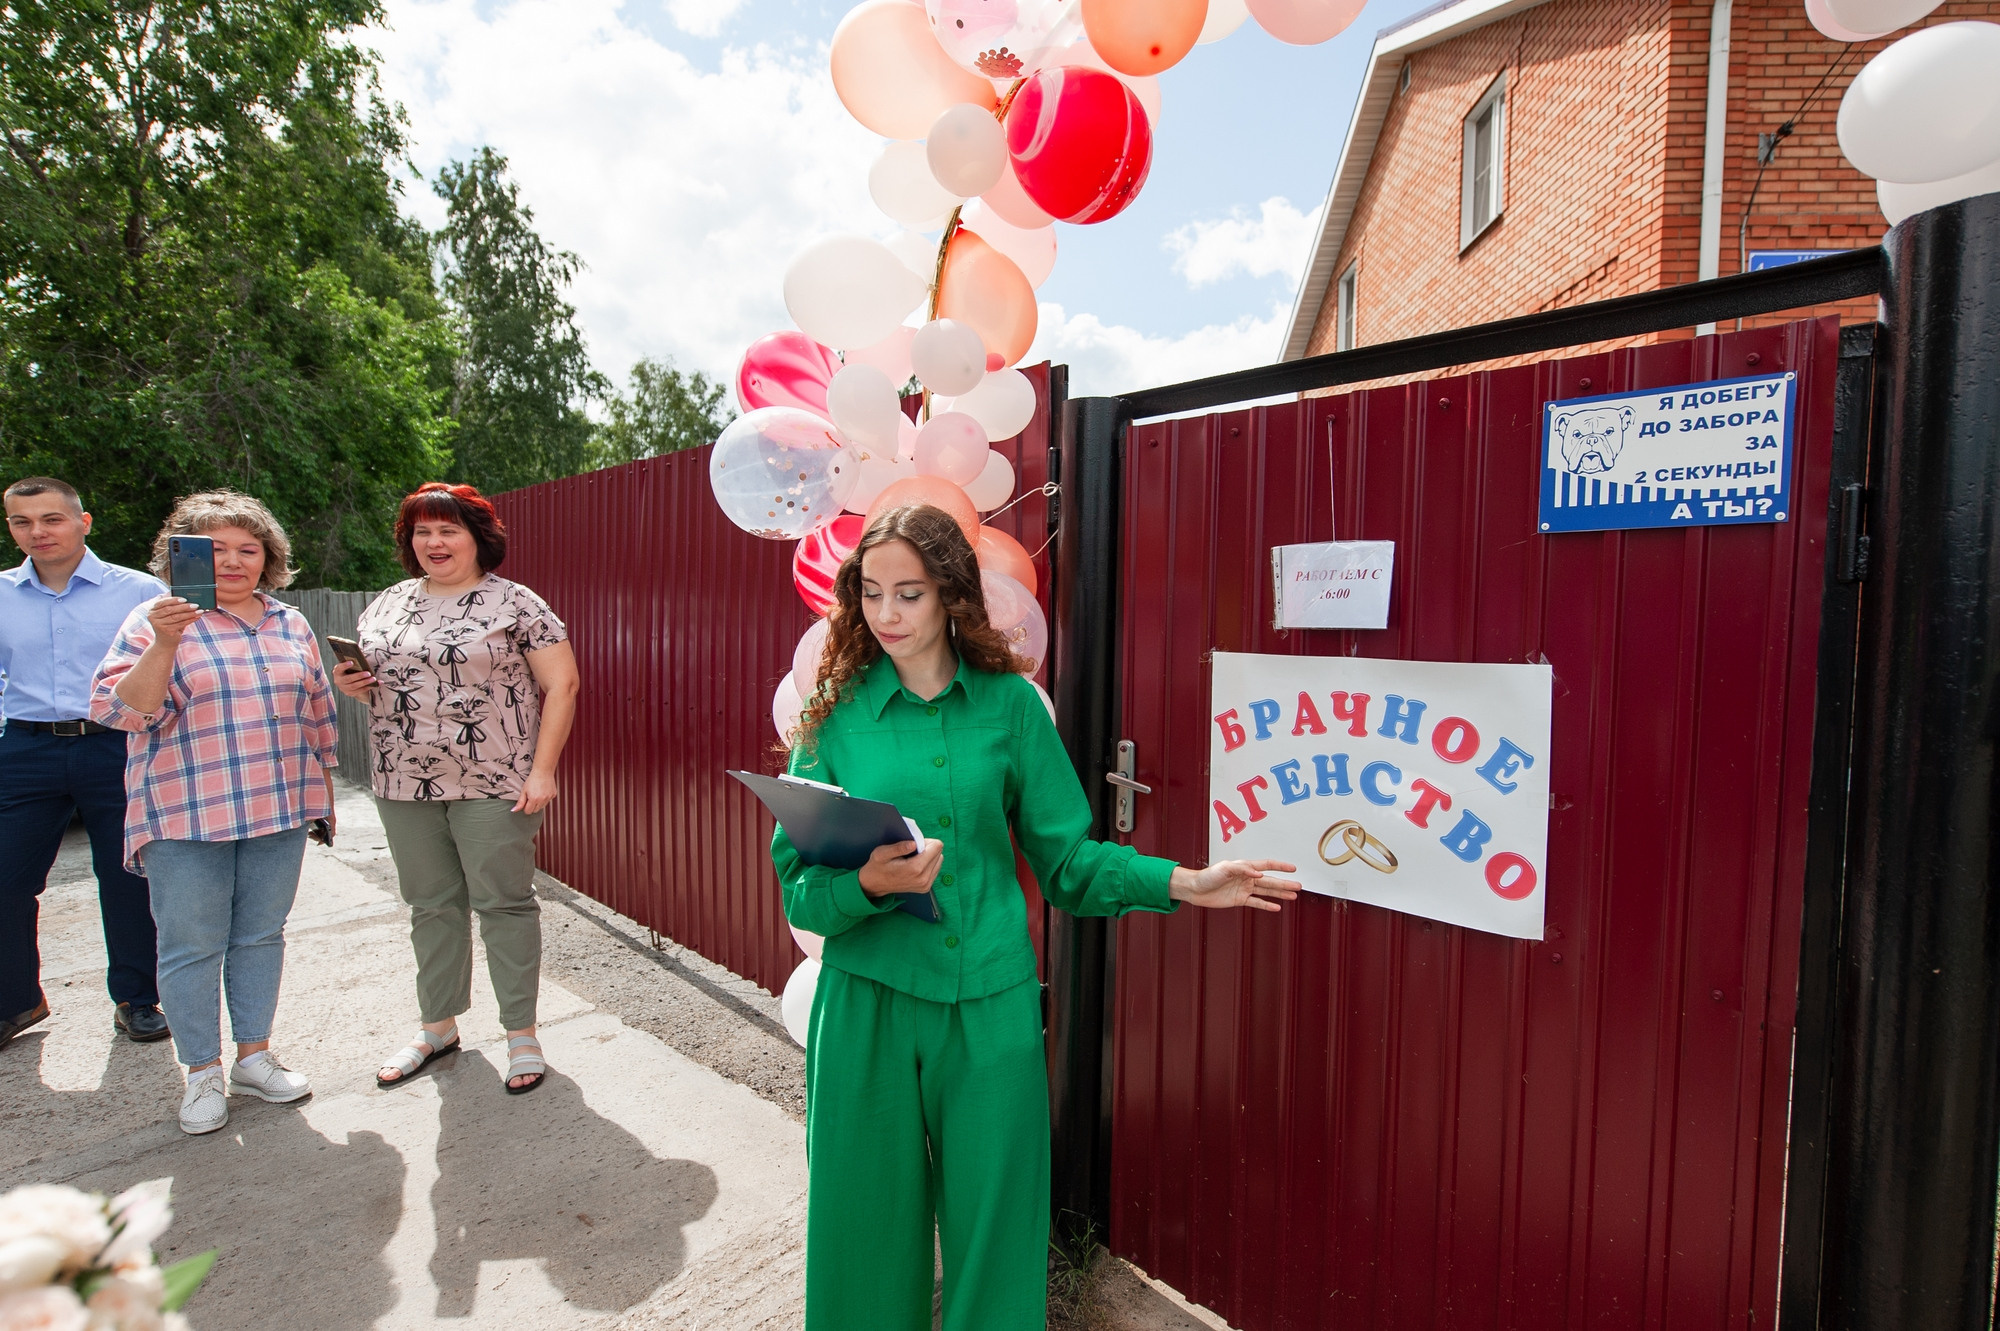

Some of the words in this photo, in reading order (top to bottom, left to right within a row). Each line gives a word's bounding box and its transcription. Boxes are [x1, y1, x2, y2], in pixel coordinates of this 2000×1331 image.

[1659, 396, 1673, 410] Я
[1681, 383, 1780, 410] ДОБЕГУ
[1639, 421, 1671, 438] ДО
[1679, 410, 1779, 432] ЗАБОРА
[1745, 435, 1777, 450] ЗА
[1635, 471, 1647, 484] 2
[1655, 460, 1776, 482] СЕКУНДЫ
[1670, 503, 1693, 519] А
[1702, 498, 1773, 518] ТЫ?
[1371, 568, 1383, 579] С
[1214, 691, 1534, 795] БРАЧНОЕ
[1213, 753, 1537, 901] АГЕНСТВО
